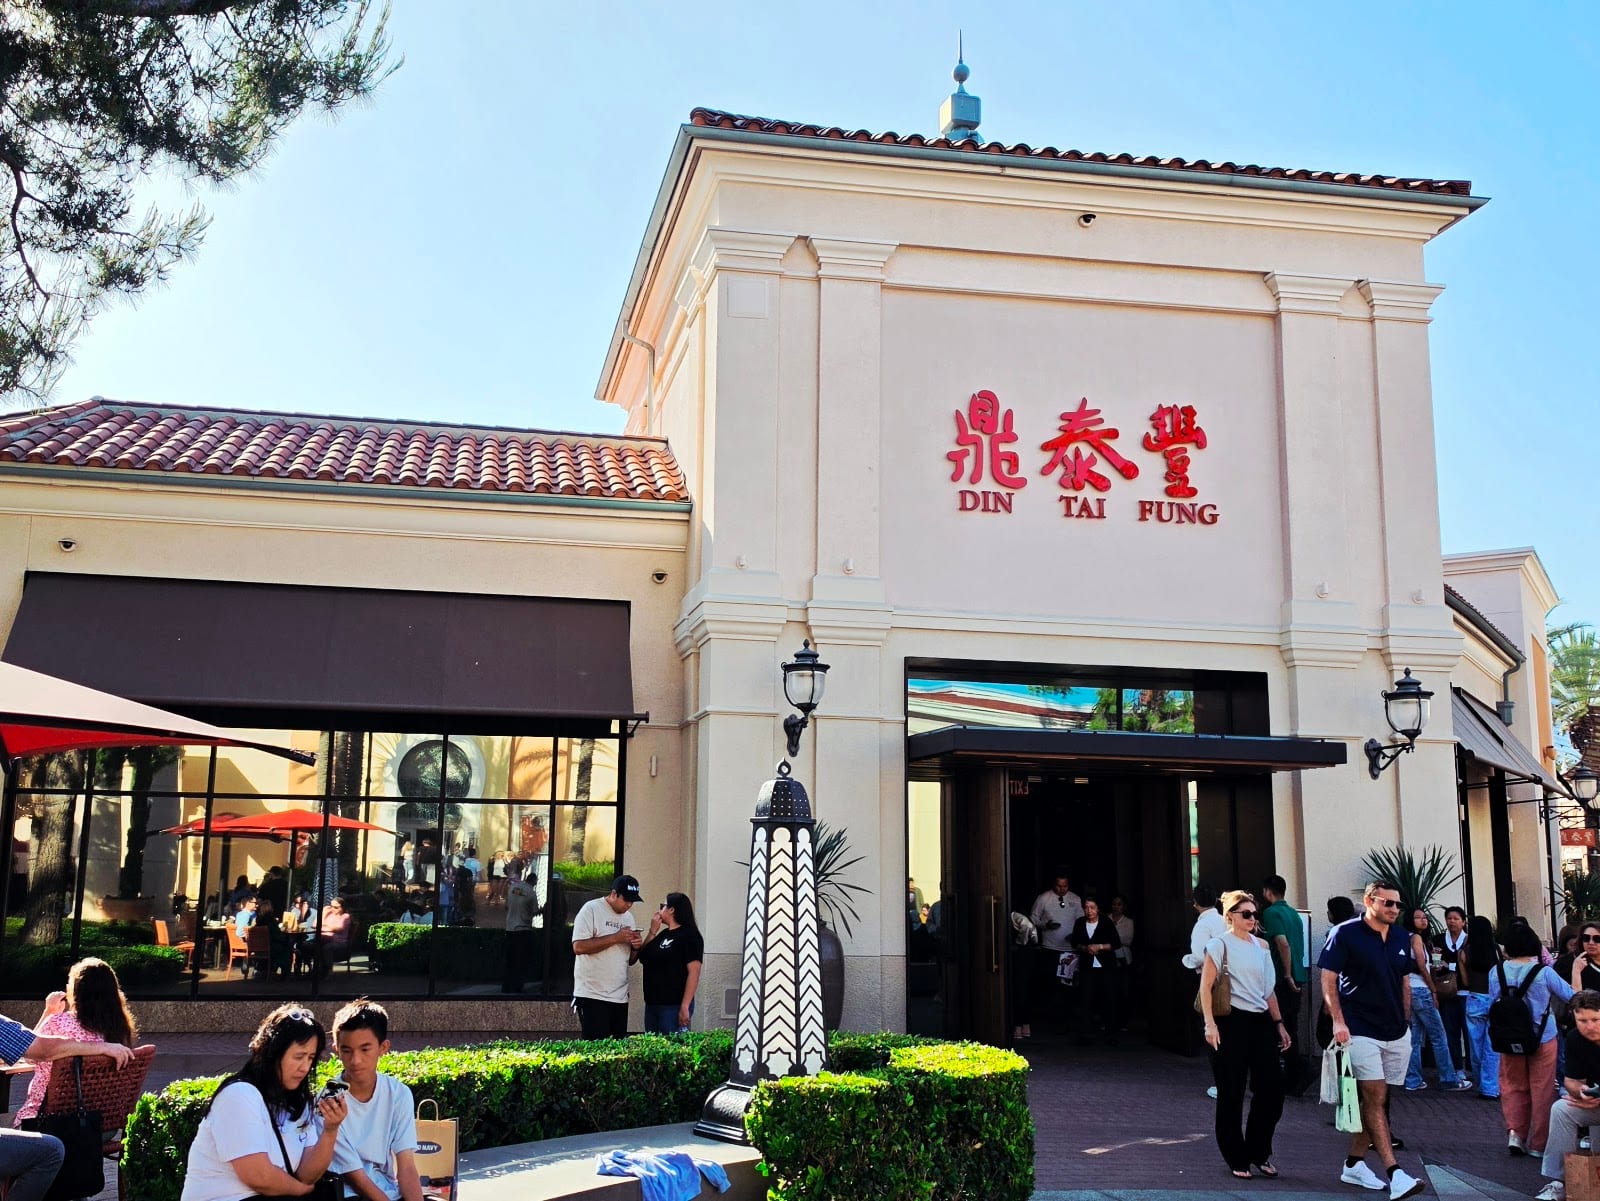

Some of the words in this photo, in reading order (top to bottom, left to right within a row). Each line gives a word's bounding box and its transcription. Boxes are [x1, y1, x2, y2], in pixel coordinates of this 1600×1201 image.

[947, 389, 1207, 498] 鼎泰豐
[958, 490, 1014, 513] DIN
[1059, 495, 1106, 519] TAI
[1138, 500, 1220, 525] FUNG
